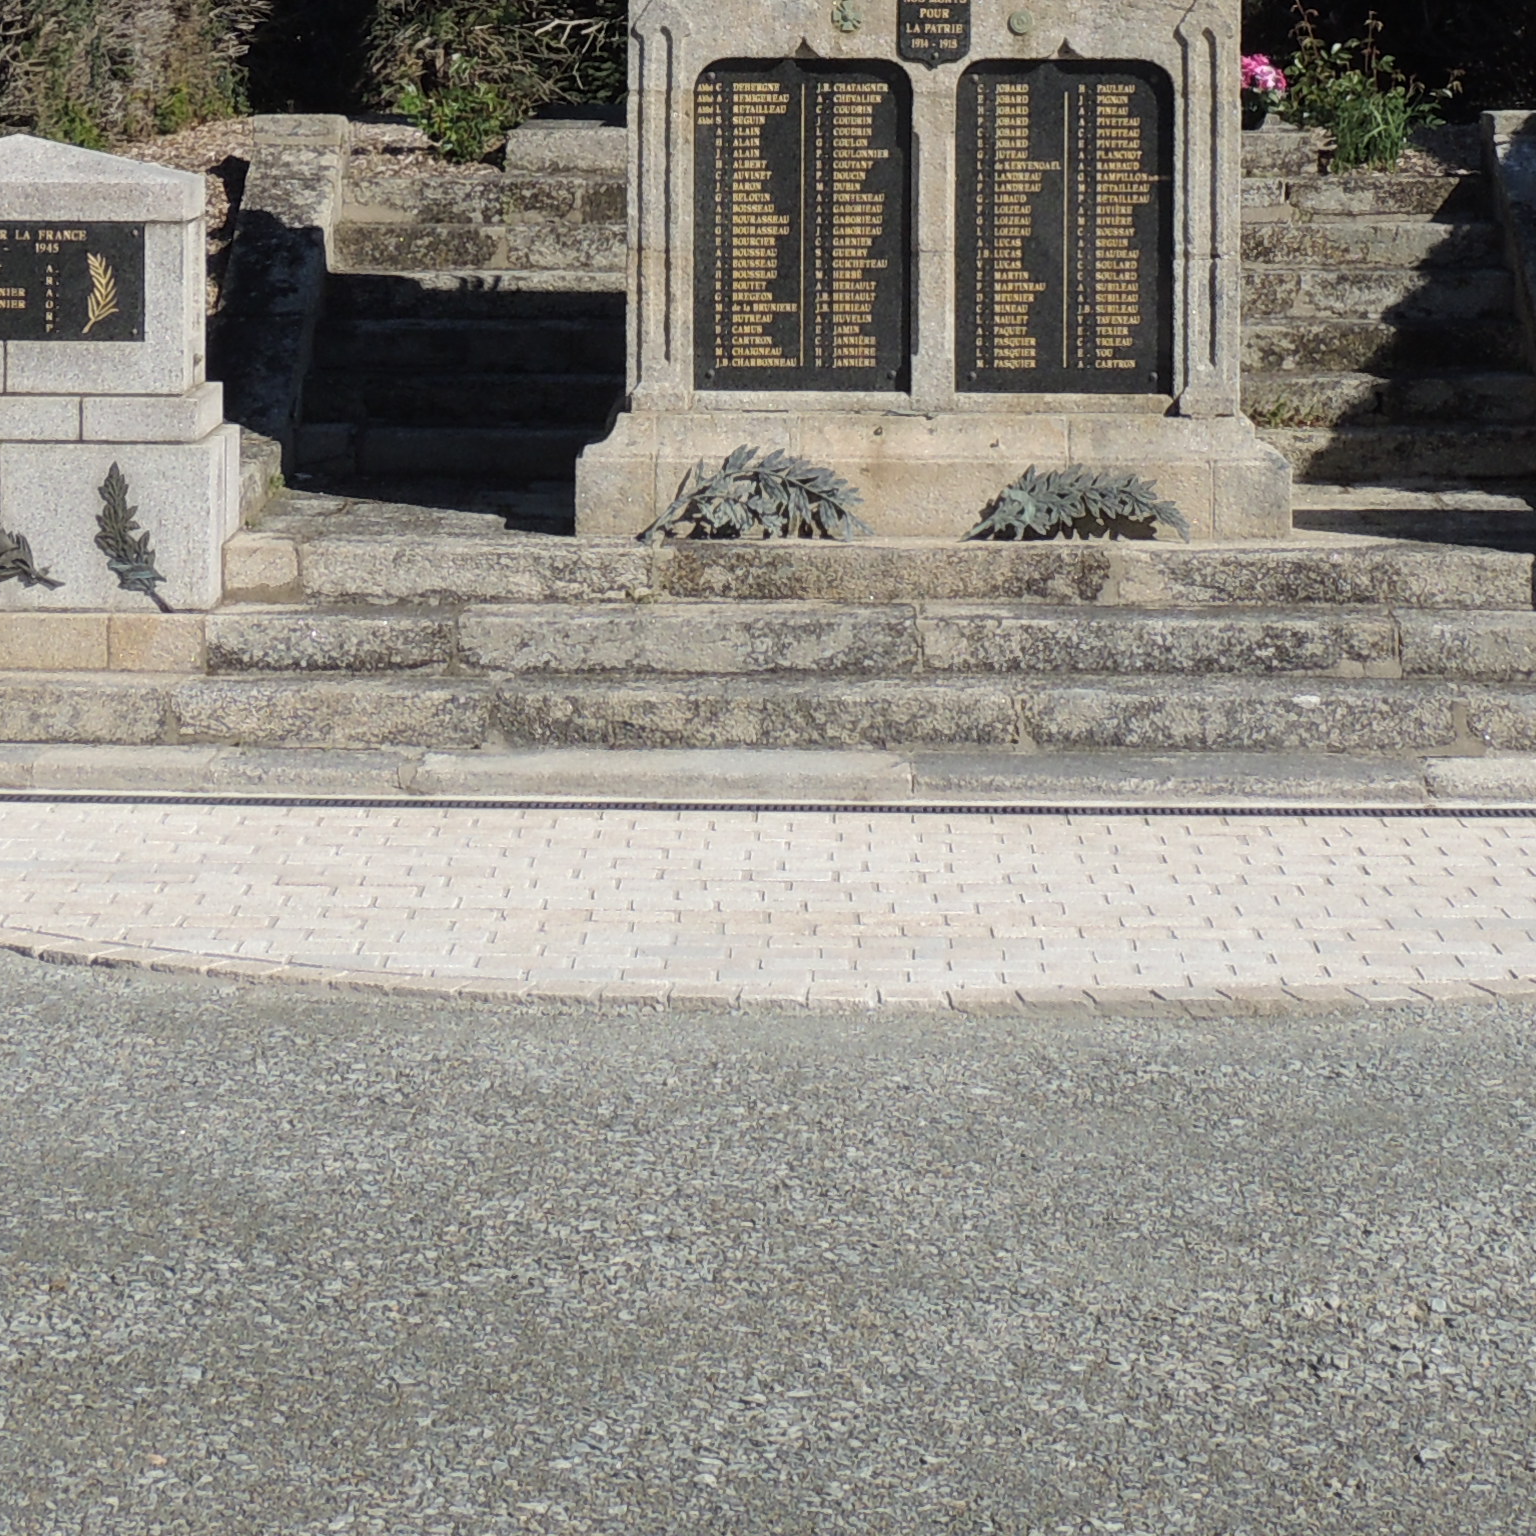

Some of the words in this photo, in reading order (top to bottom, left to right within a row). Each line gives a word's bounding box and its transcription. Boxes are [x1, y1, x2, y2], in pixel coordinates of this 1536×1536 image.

[920, 8, 950, 18] POUR
[906, 23, 920, 33] LA
[924, 24, 963, 34] PATRIE
[911, 38, 928, 48] 1914
[733, 127, 760, 136] ALAIN
[733, 138, 759, 147] ALAIN
[733, 149, 759, 158] ALAIN
[15, 230, 31, 240] LA
[38, 230, 87, 241] FRANCE
[994, 238, 1021, 247] LUCAS
[35, 243, 59, 253] 1945
[994, 249, 1021, 258] LUCAS
[994, 260, 1021, 269] LUCAS
[1095, 348, 1113, 357] YOU
